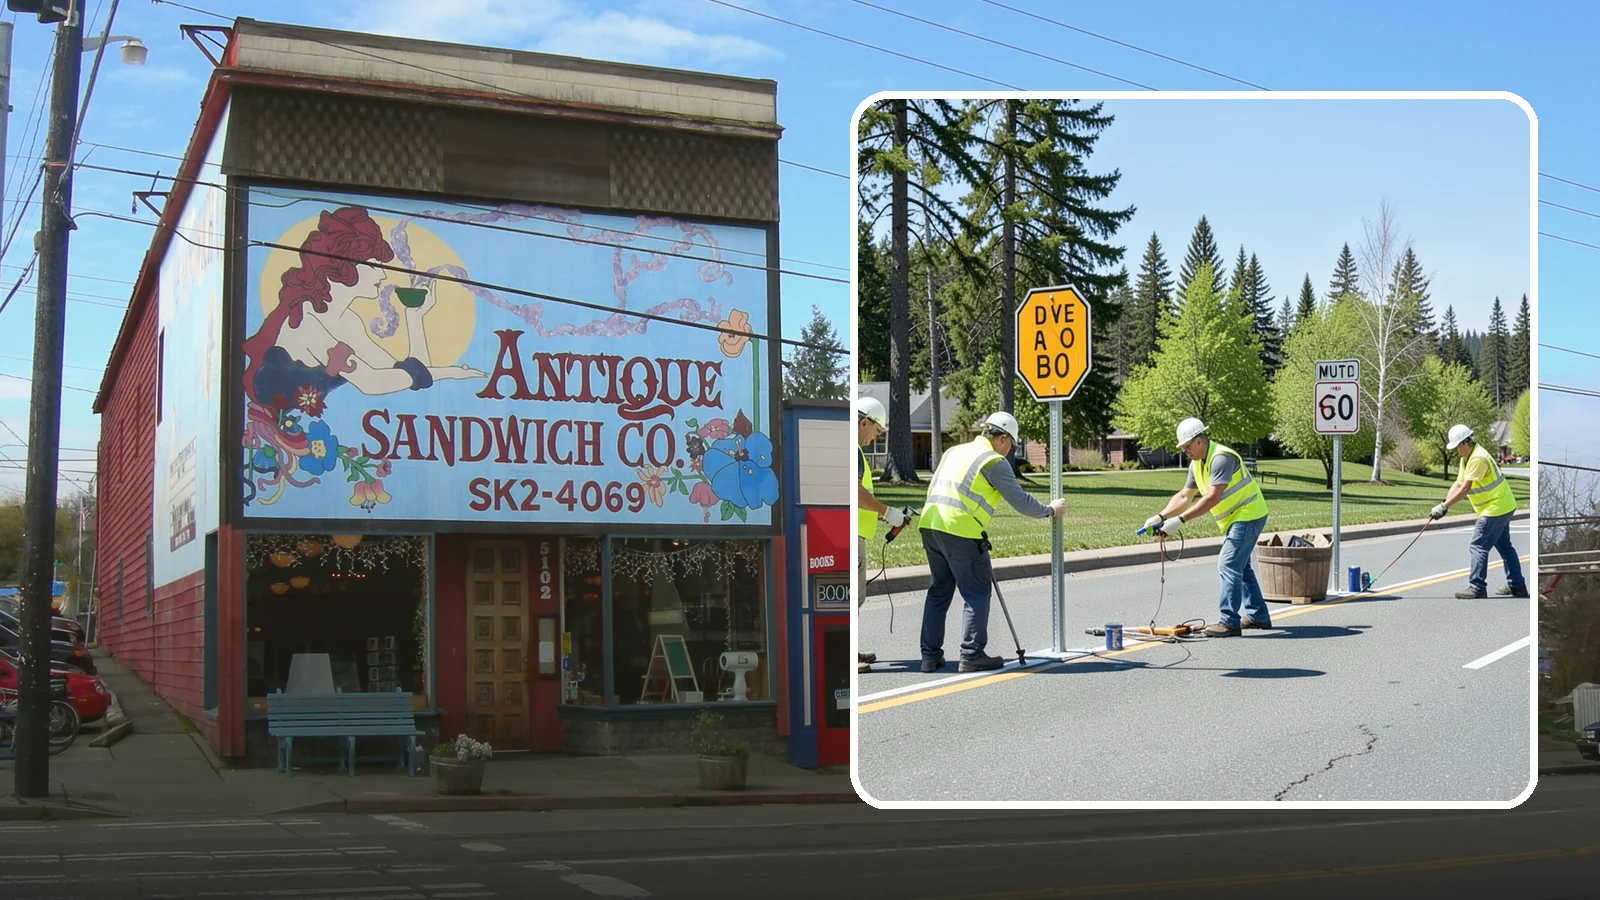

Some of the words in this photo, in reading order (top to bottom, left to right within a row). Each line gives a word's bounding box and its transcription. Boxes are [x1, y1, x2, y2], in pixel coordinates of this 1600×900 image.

[476, 329, 724, 420] ANTIQUE
[1036, 353, 1070, 379] BO
[1318, 393, 1354, 421] 60
[361, 408, 604, 467] SANDWICH
[616, 422, 685, 469] CO.
[468, 476, 645, 513] SK2-4069
[540, 541, 552, 599] 5102
[809, 555, 835, 569] BOOKS
